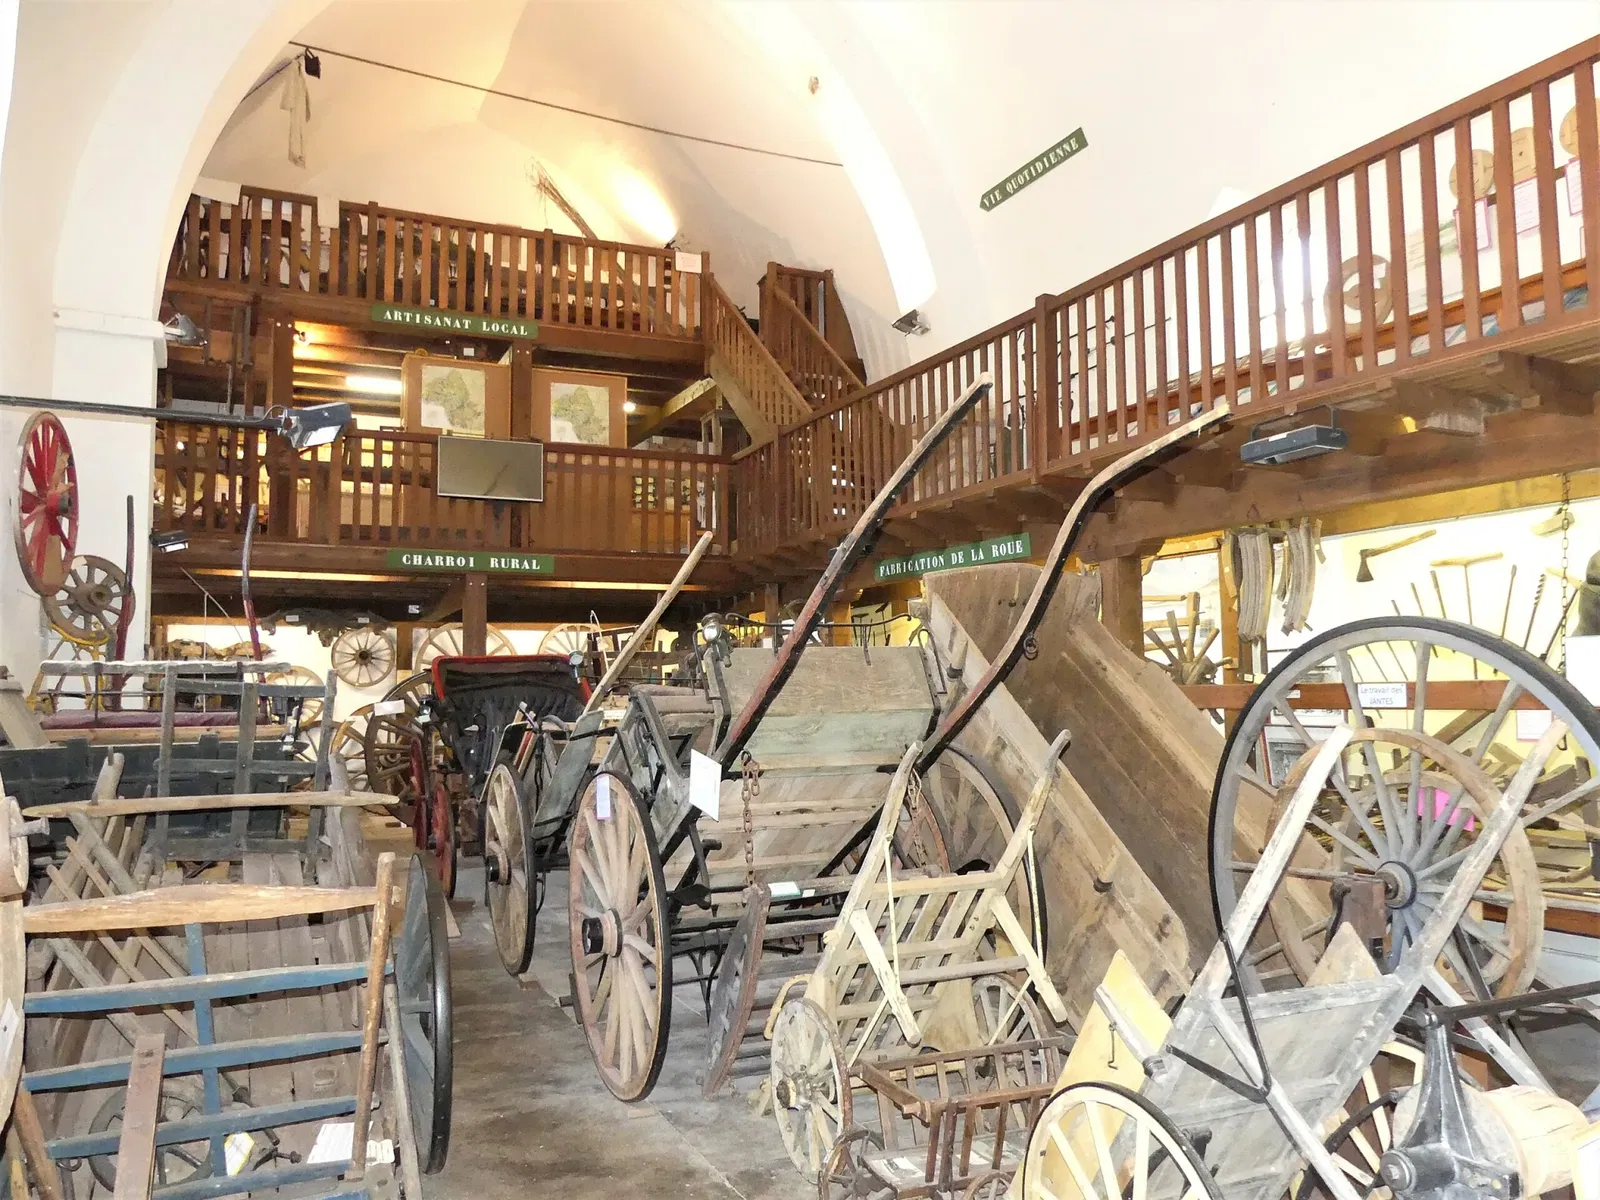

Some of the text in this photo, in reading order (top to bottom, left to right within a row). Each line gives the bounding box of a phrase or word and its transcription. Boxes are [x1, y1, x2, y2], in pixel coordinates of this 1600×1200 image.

[983, 137, 1079, 208] VIE QUOTIDIENNE
[383, 310, 528, 336] ARTISANAT LOCAL
[402, 554, 540, 570] CHARROI RURAL
[879, 540, 1023, 577] FABRICATION DE LA ROUE
